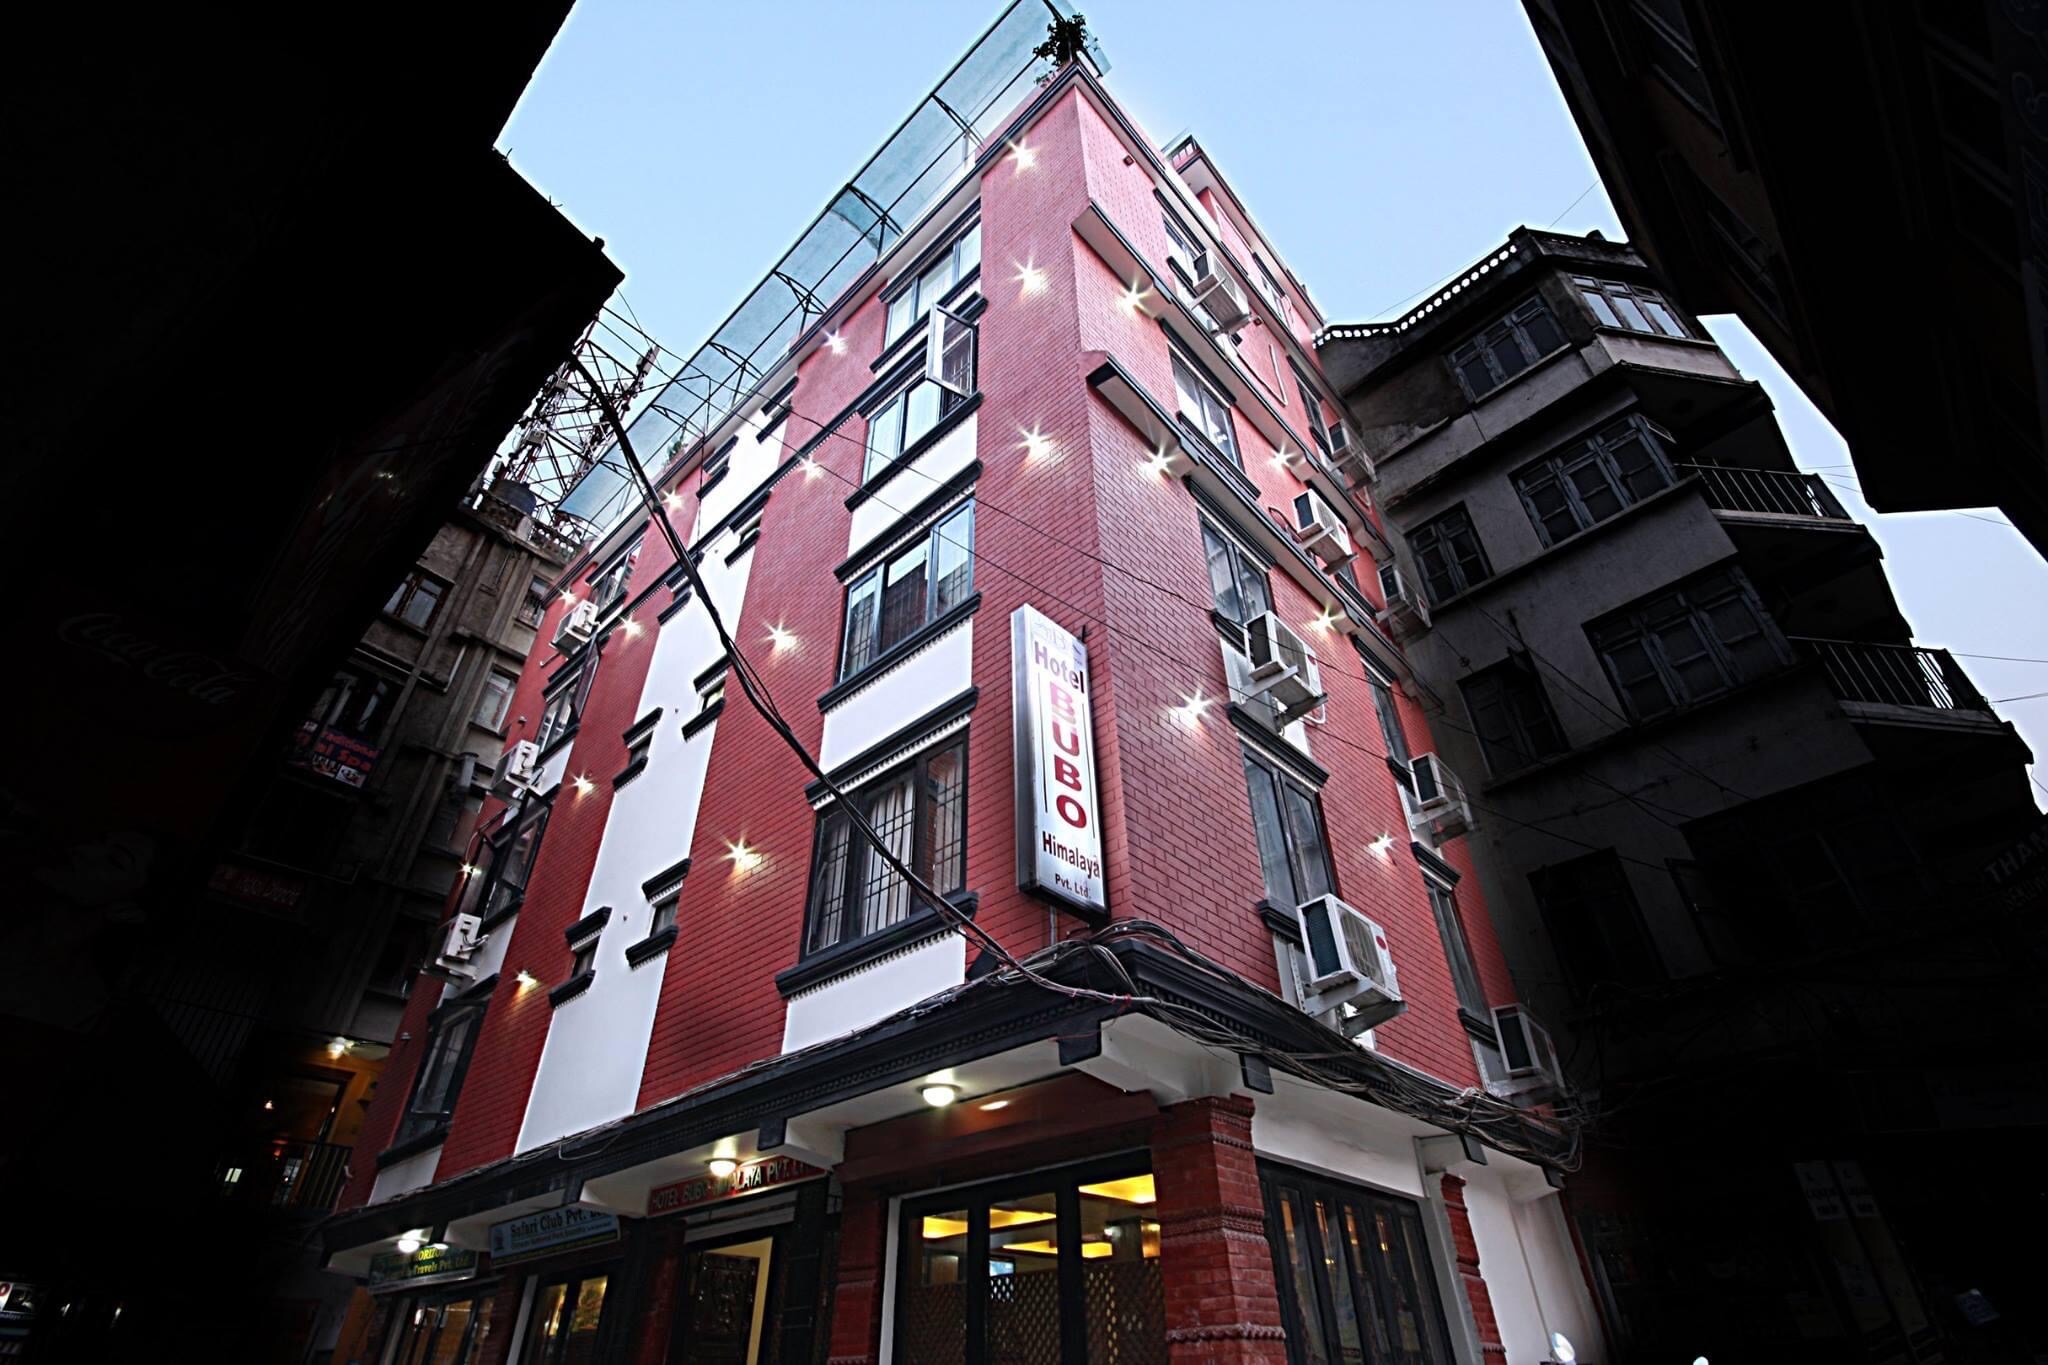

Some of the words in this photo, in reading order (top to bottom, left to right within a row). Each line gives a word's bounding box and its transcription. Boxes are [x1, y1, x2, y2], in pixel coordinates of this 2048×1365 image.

[1034, 639, 1085, 694] Hotel
[1050, 681, 1088, 830] BUBO
[1042, 830, 1101, 880] Himalaya
[1055, 873, 1072, 892] Pvt.
[653, 1186, 679, 1210] HOTEL
[712, 1164, 762, 1198] ALAYA
[540, 1211, 563, 1231] Club
